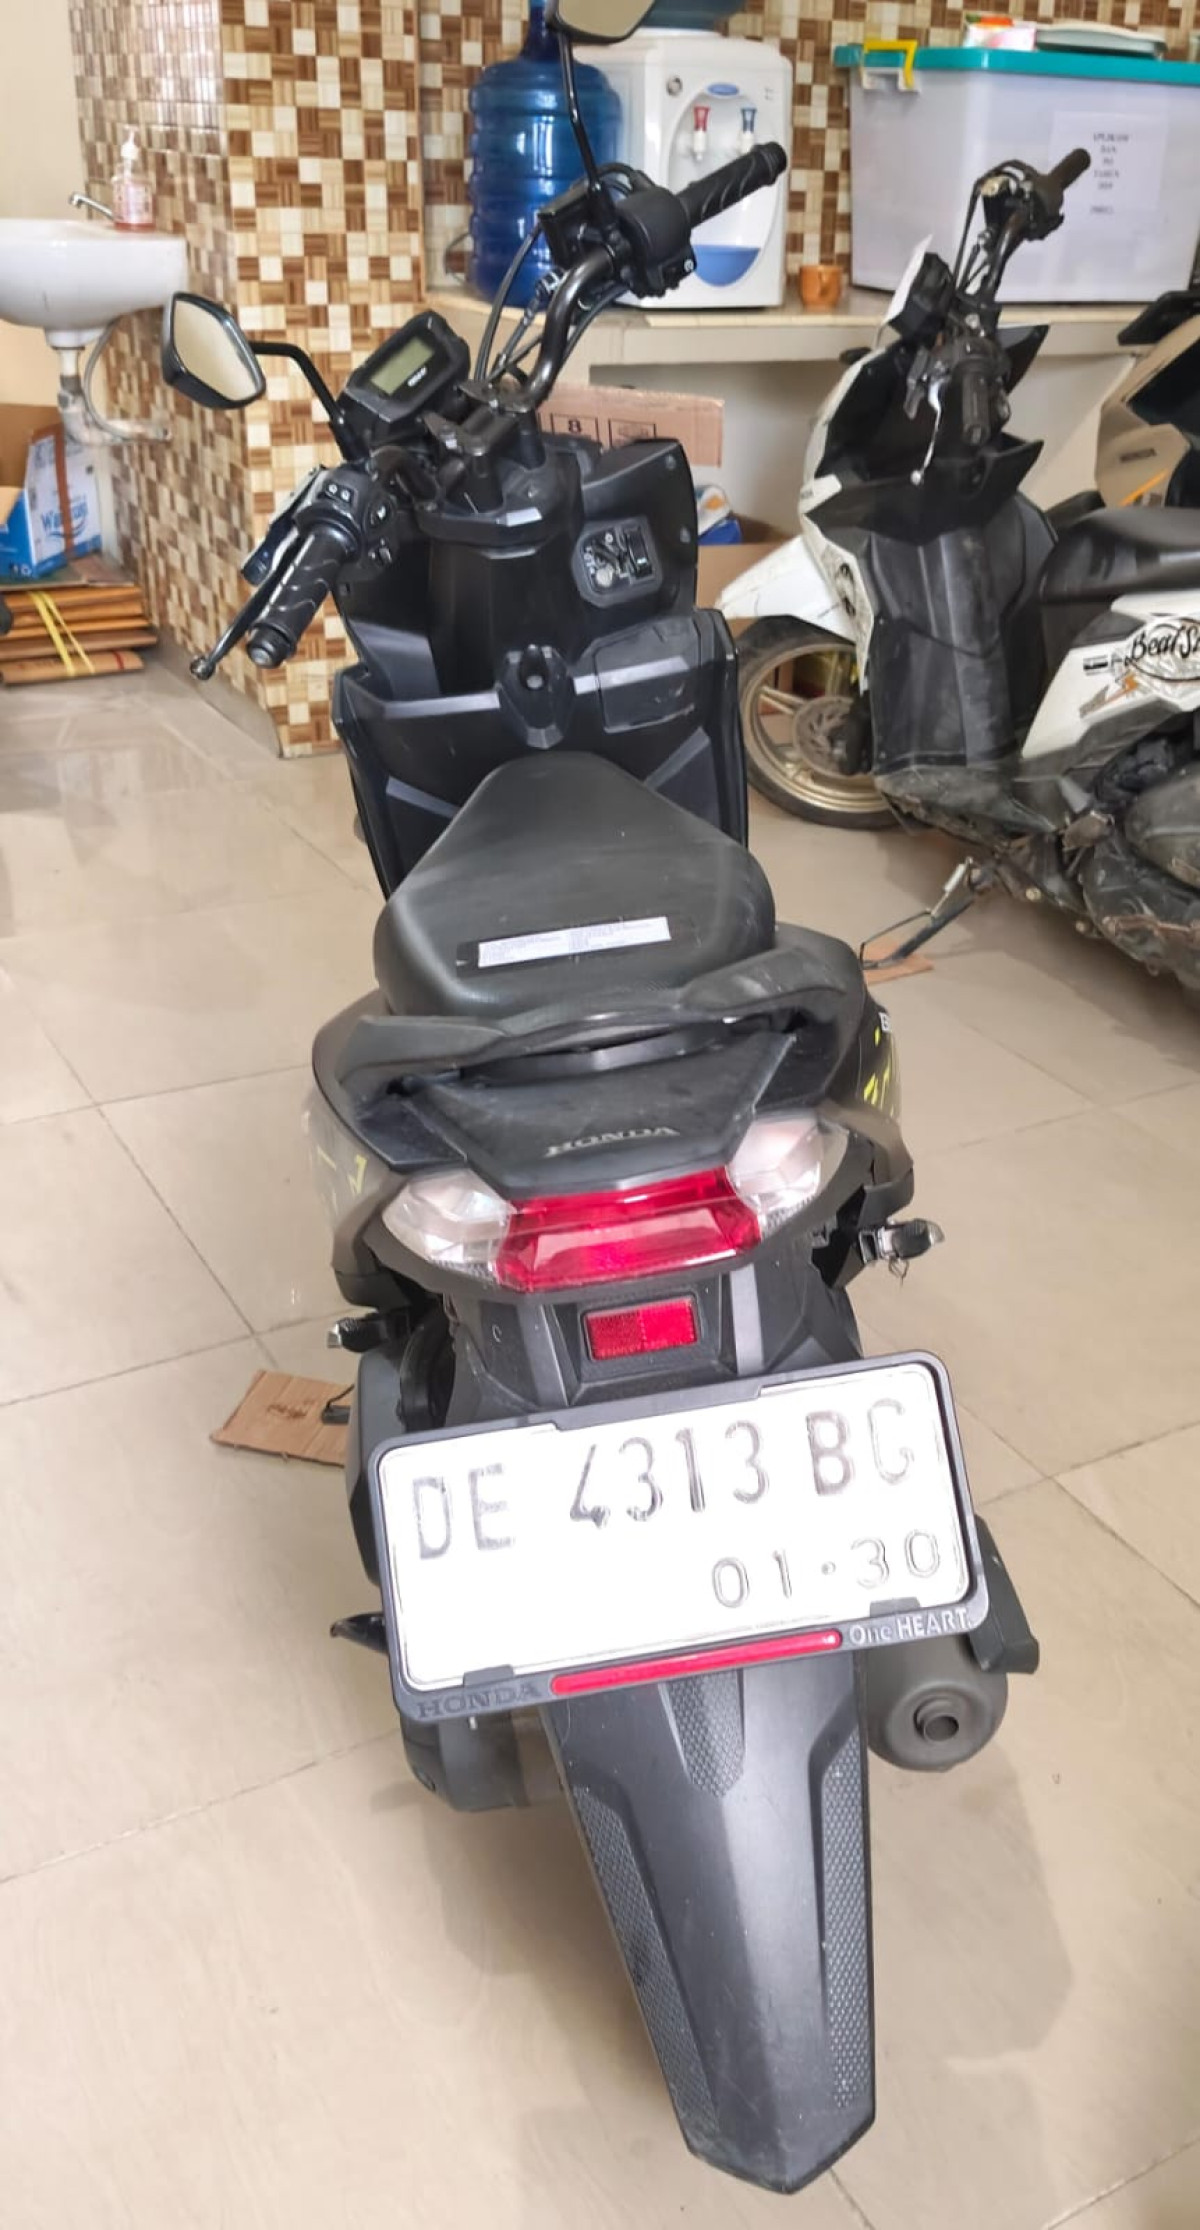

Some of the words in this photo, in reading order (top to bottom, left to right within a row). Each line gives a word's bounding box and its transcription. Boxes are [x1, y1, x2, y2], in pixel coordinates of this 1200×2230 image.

[568, 419, 582, 434] 8
[411, 1462, 516, 1560] DE
[569, 1419, 770, 1529] 4313
[849, 1624, 893, 1646] One
[417, 1682, 542, 1718] HONDA
